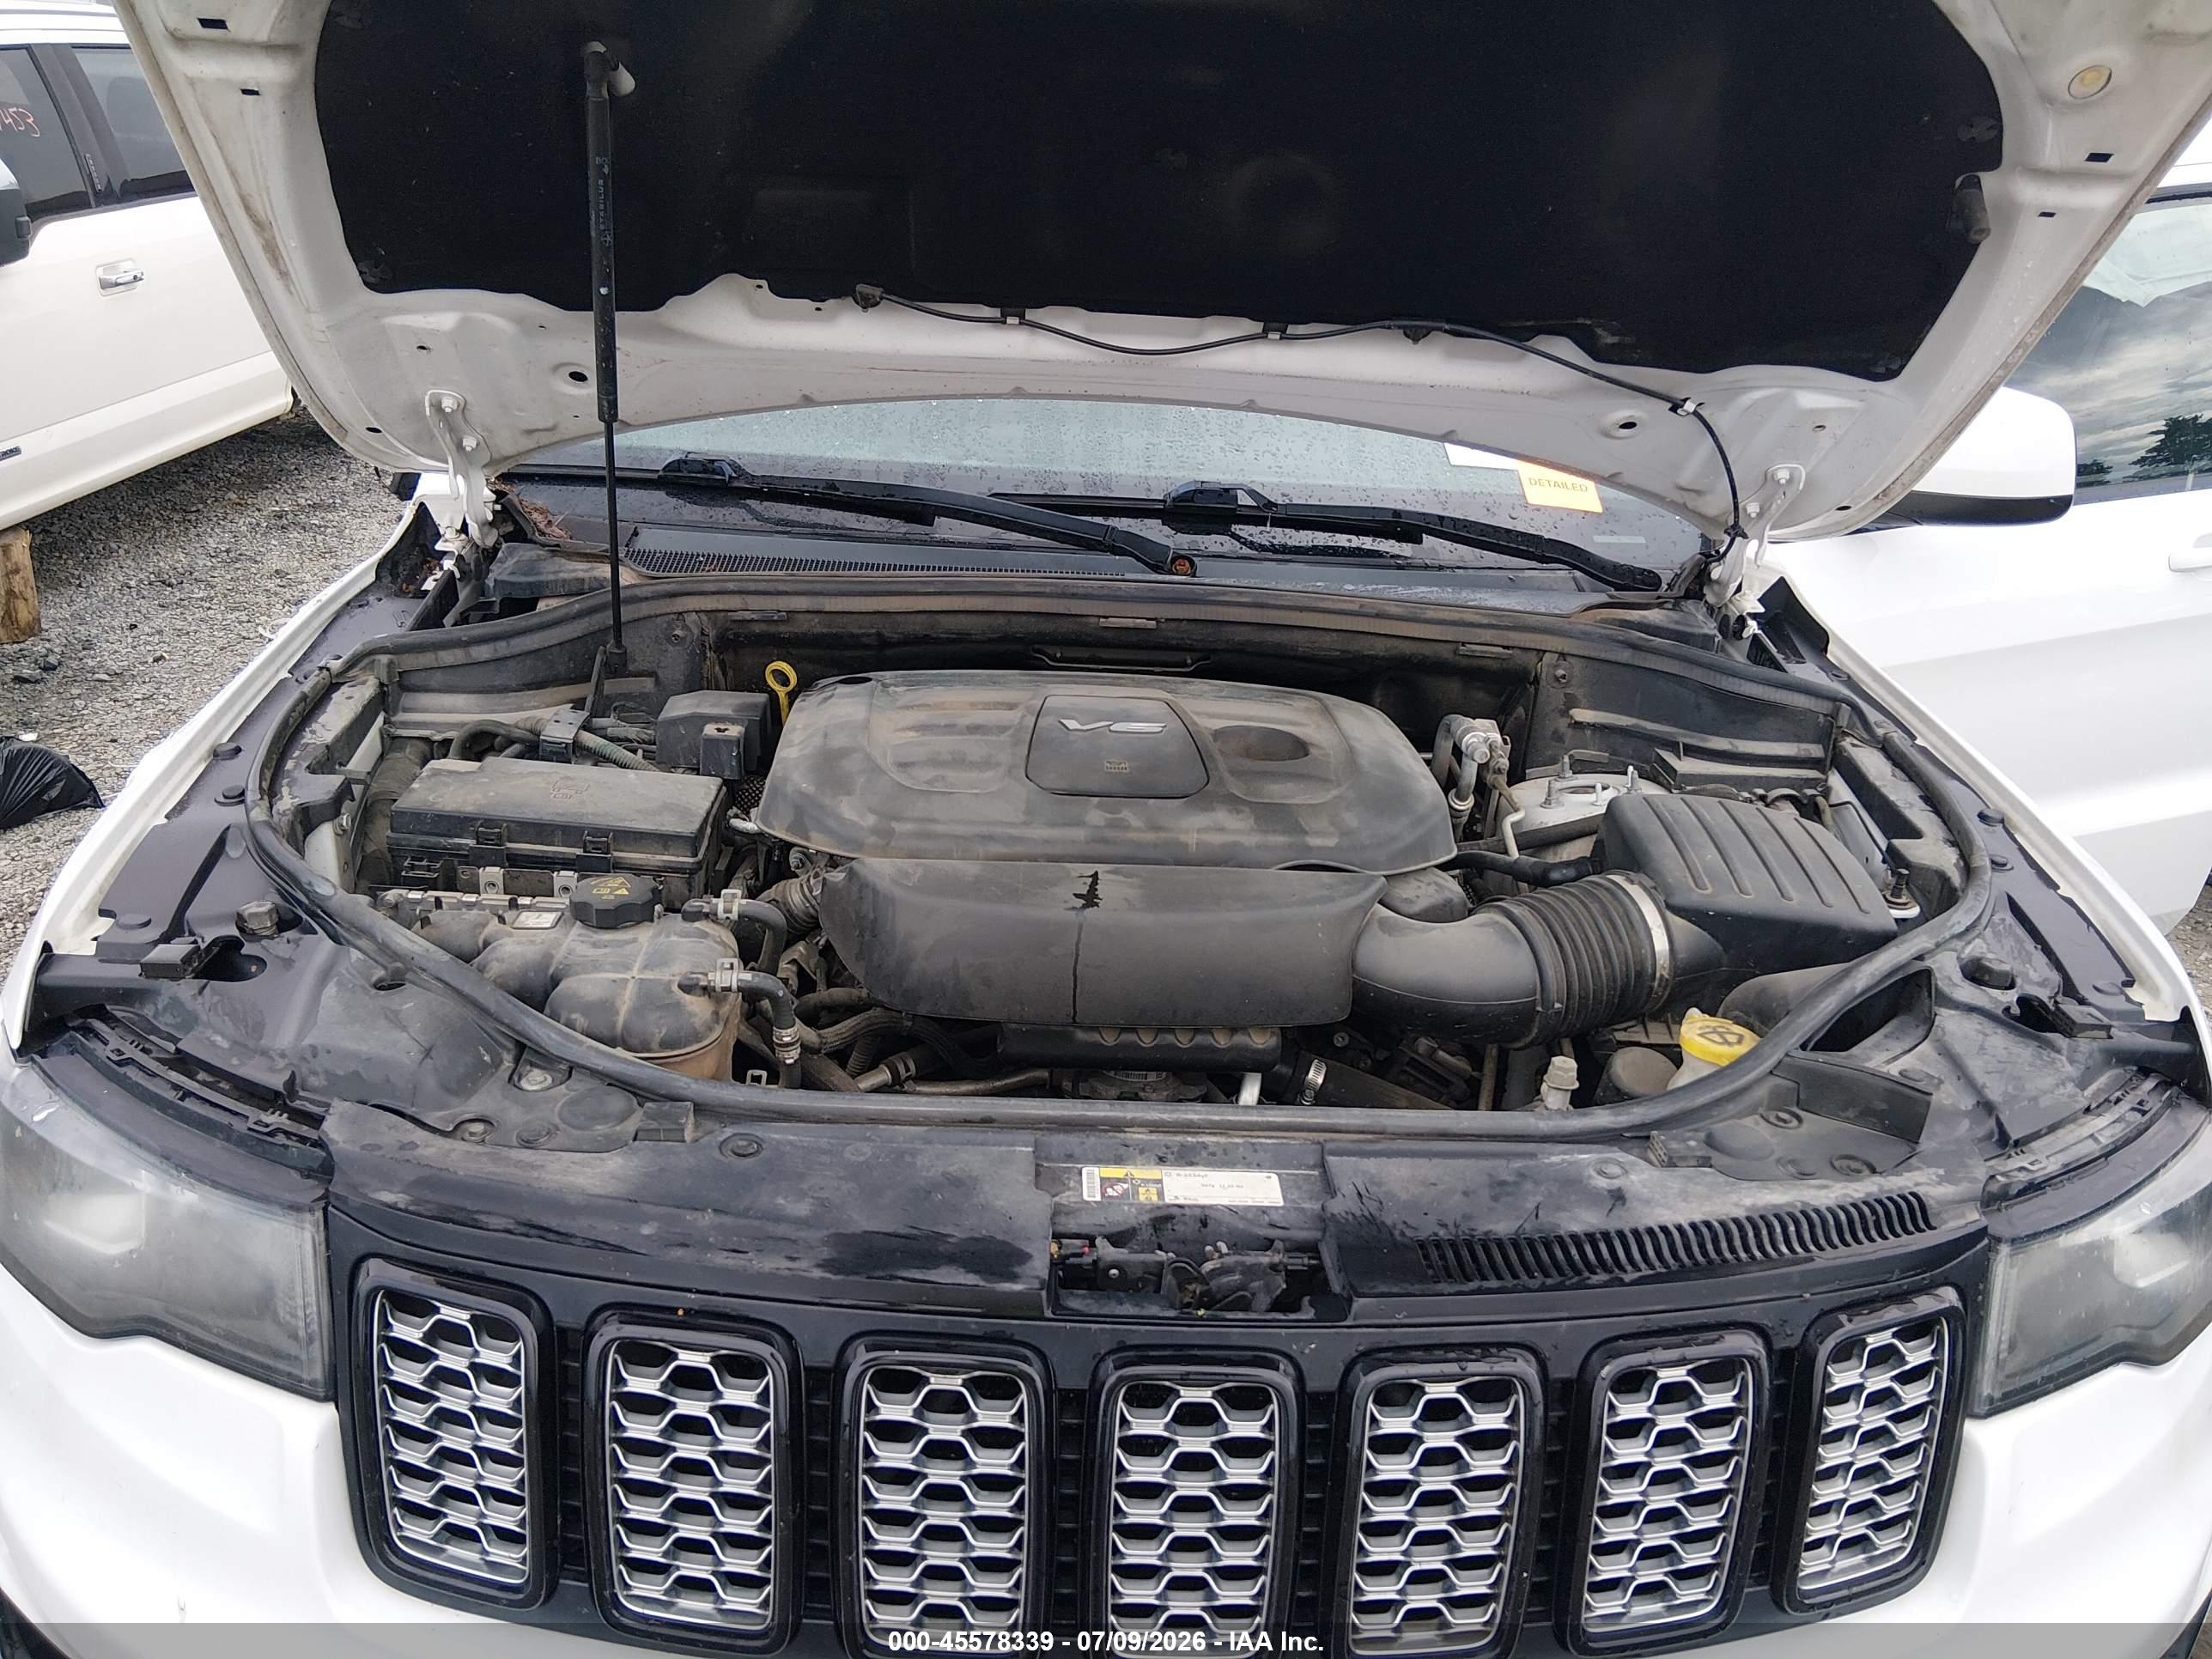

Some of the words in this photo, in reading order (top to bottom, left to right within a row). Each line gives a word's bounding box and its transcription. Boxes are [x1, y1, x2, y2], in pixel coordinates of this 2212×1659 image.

[0, 106, 40, 137] 453
[1528, 477, 1588, 493] DETAILED
[1057, 718, 1168, 733] V6
